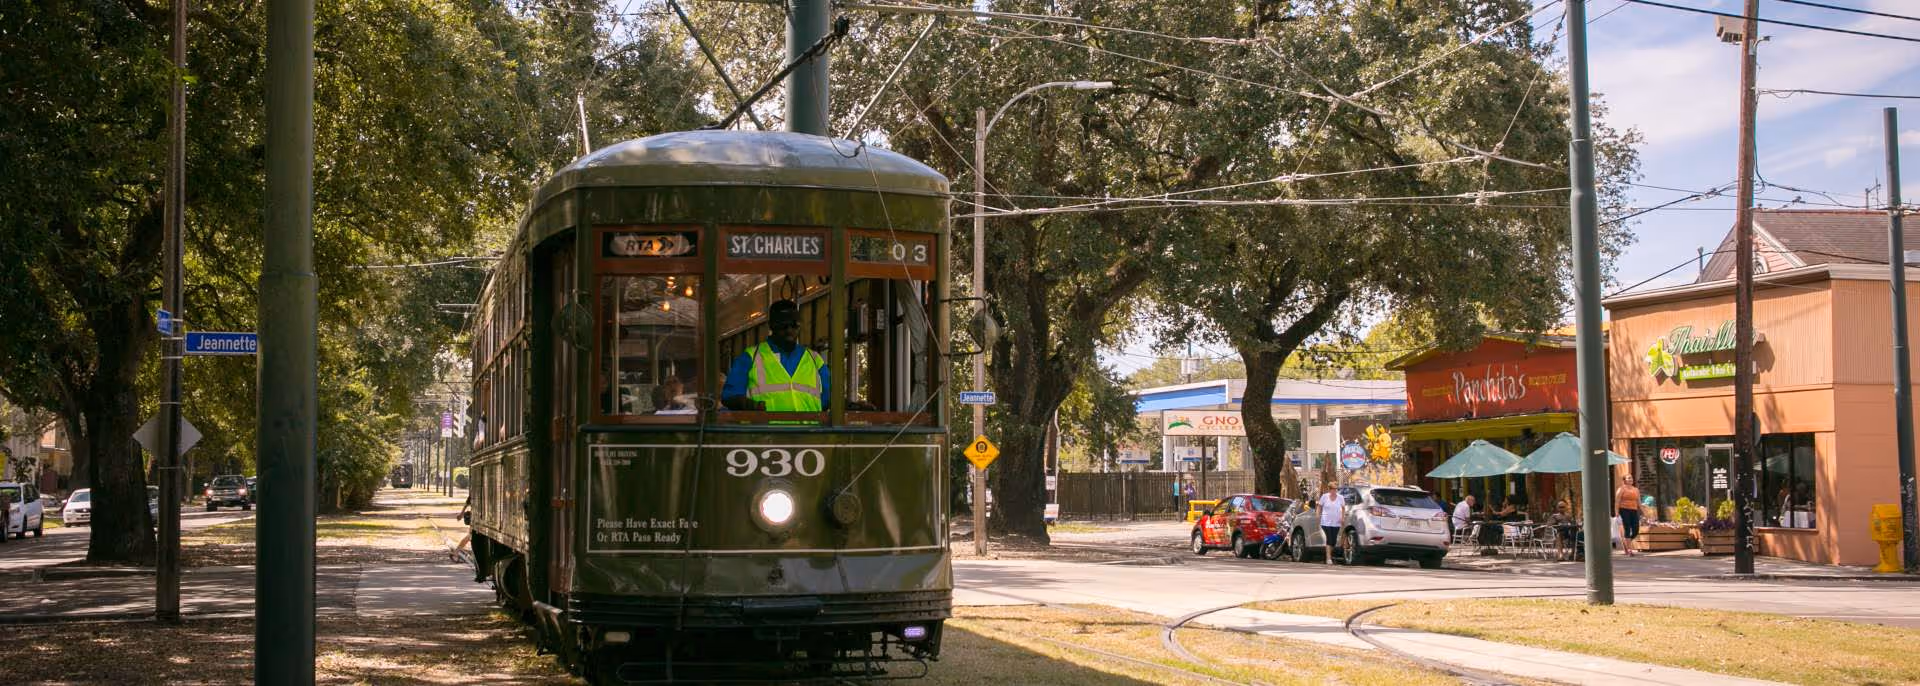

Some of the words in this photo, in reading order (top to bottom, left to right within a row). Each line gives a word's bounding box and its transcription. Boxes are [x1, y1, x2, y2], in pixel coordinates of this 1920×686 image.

[625, 239, 655, 252] RTA
[731, 235, 752, 254] ST.
[754, 235, 819, 255] CHARLES
[196, 335, 257, 351] Jeannette
[1452, 362, 1527, 404] Panchita's
[962, 392, 993, 404] Jeannette
[1202, 416, 1239, 425] GNO
[726, 448, 825, 477] 930
[597, 518, 624, 529] Please
[626, 518, 648, 529] Have
[650, 518, 676, 529] Exact
[597, 532, 608, 542] Or
[611, 532, 630, 542] RTA
[633, 532, 652, 542] Pass
[654, 532, 681, 544] Ready
